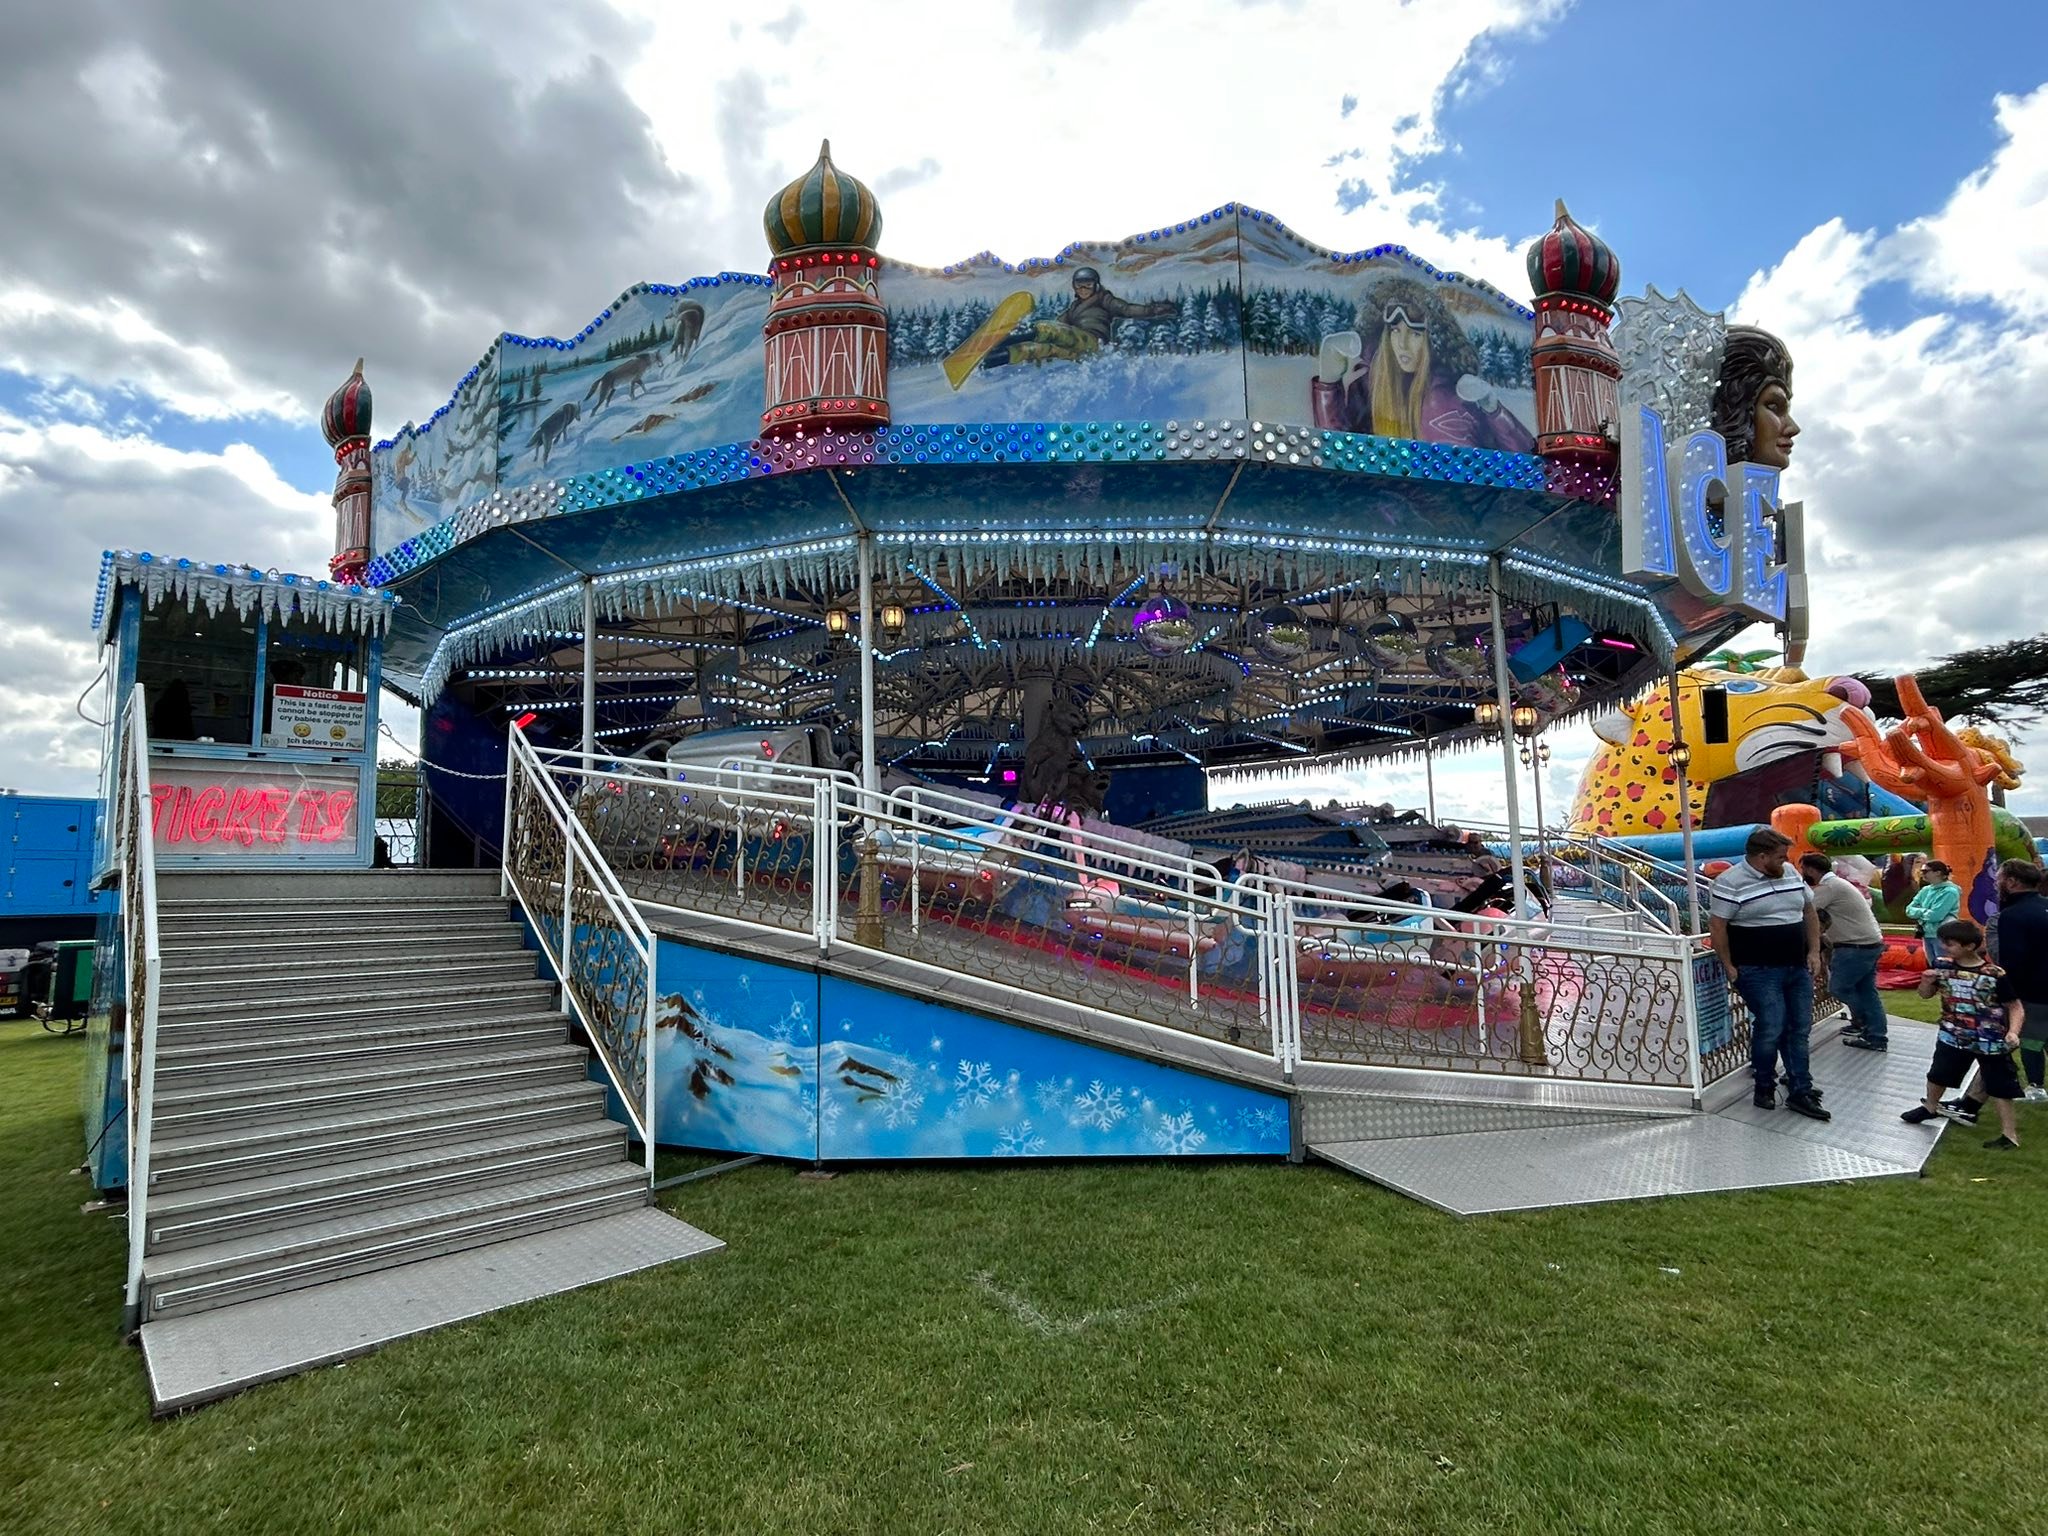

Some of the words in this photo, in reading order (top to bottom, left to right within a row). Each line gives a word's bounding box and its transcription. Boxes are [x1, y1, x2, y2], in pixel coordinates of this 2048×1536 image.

[1622, 403, 1788, 622] ICE
[303, 690, 339, 699] Notice
[279, 699, 297, 707] This
[331, 703, 347, 711] ride
[277, 707, 305, 715] cannot
[319, 710, 351, 719] stopped
[352, 712, 363, 720] for
[294, 715, 321, 723] babies
[302, 738, 328, 746] before
[149, 784, 354, 847] TICKETS
[1695, 964, 1709, 984] ICE
